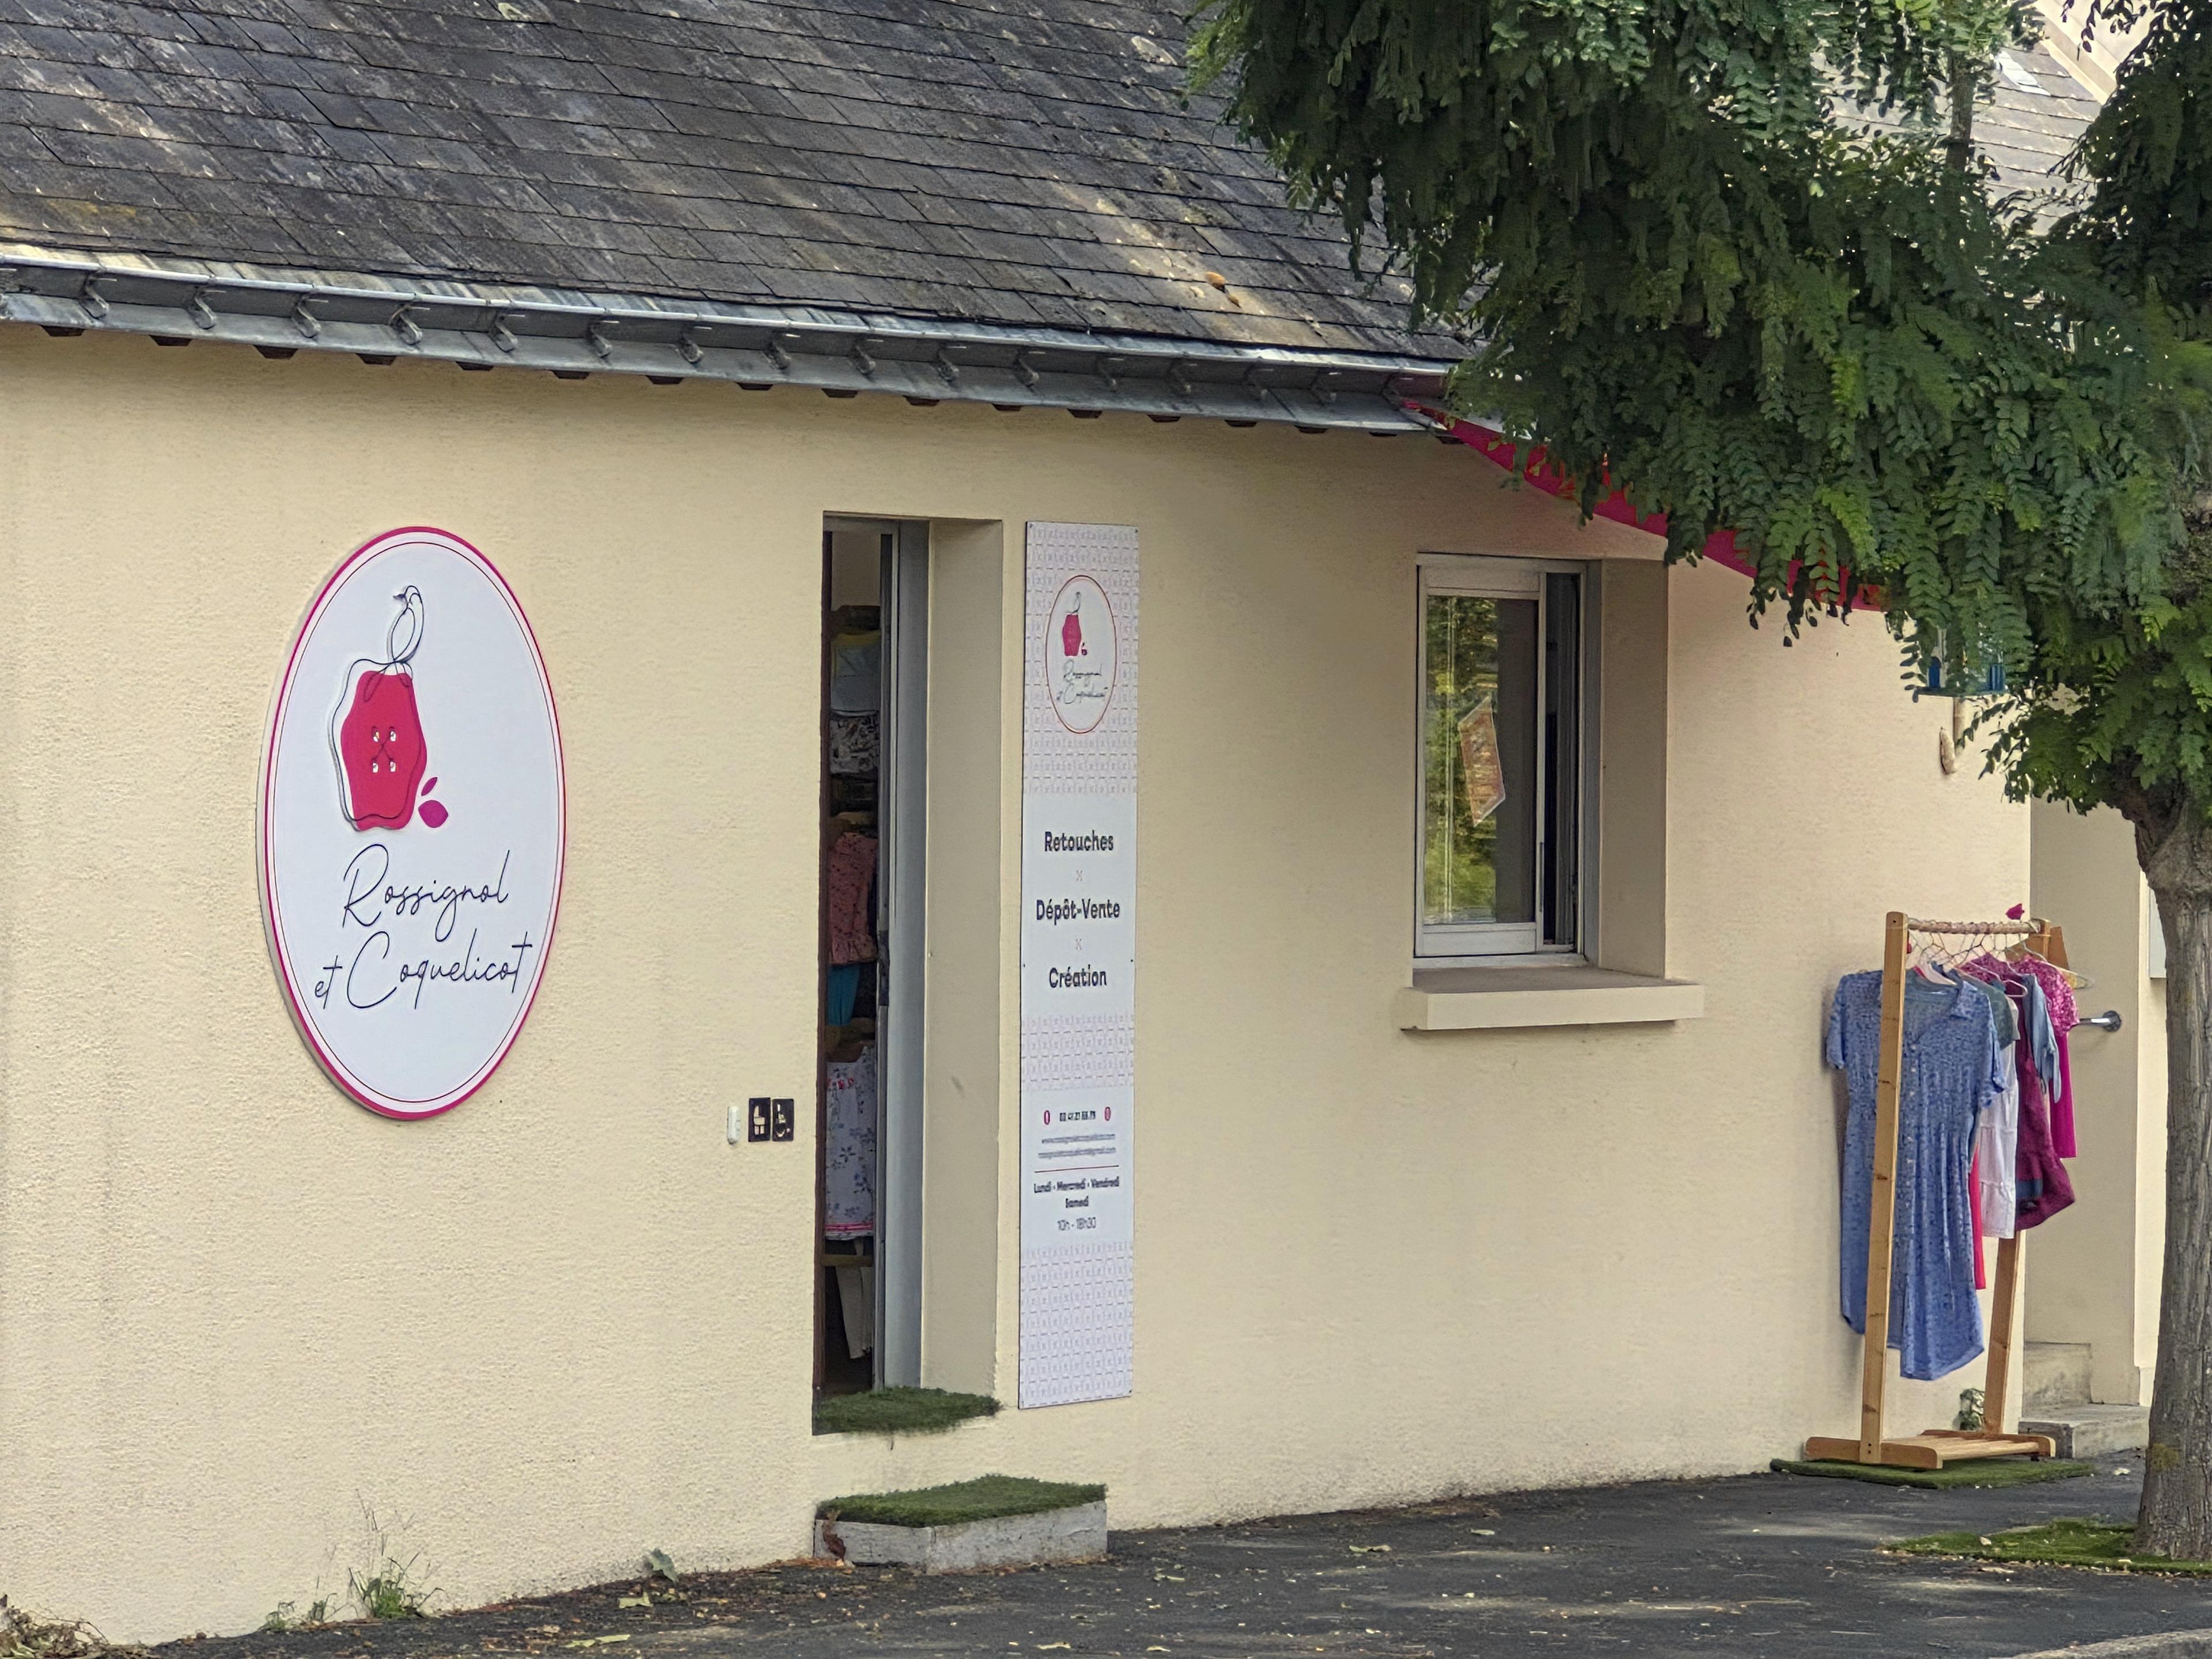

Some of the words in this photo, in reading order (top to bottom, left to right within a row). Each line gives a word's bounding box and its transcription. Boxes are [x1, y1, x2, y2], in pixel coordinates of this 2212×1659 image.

[1044, 830, 1114, 851] Retouches
[342, 843, 510, 942] Rossignol
[1036, 899, 1120, 925] Dépôt-Vente
[315, 955, 343, 1010] et
[346, 927, 533, 1010] Coquelicot
[1049, 964, 1108, 988] Création
